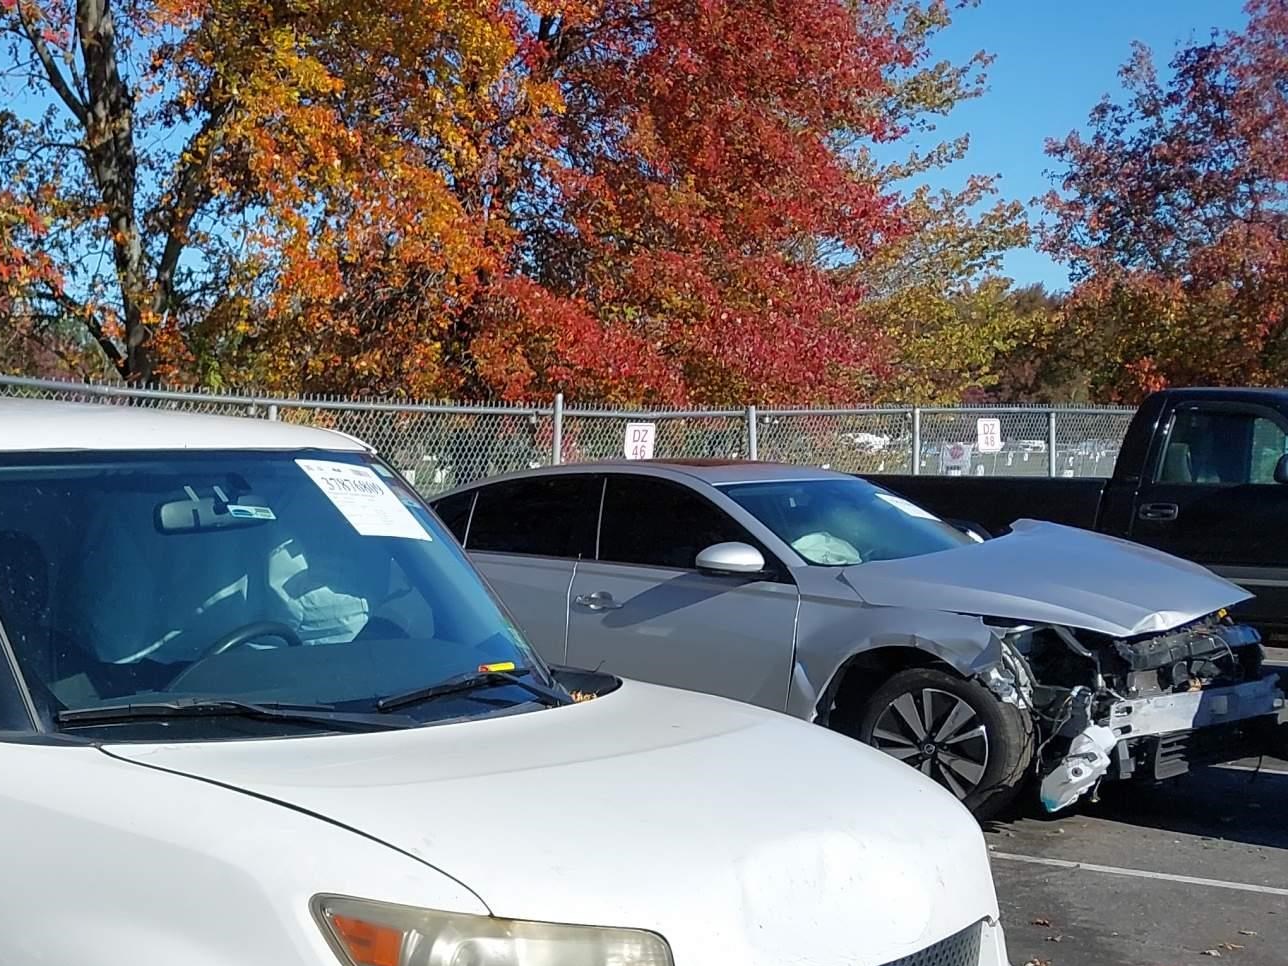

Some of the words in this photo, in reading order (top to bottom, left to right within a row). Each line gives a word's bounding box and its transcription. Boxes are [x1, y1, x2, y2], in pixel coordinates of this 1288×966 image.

[632, 429, 649, 442] DZ
[983, 423, 996, 435] DZ
[631, 445, 646, 460] 46
